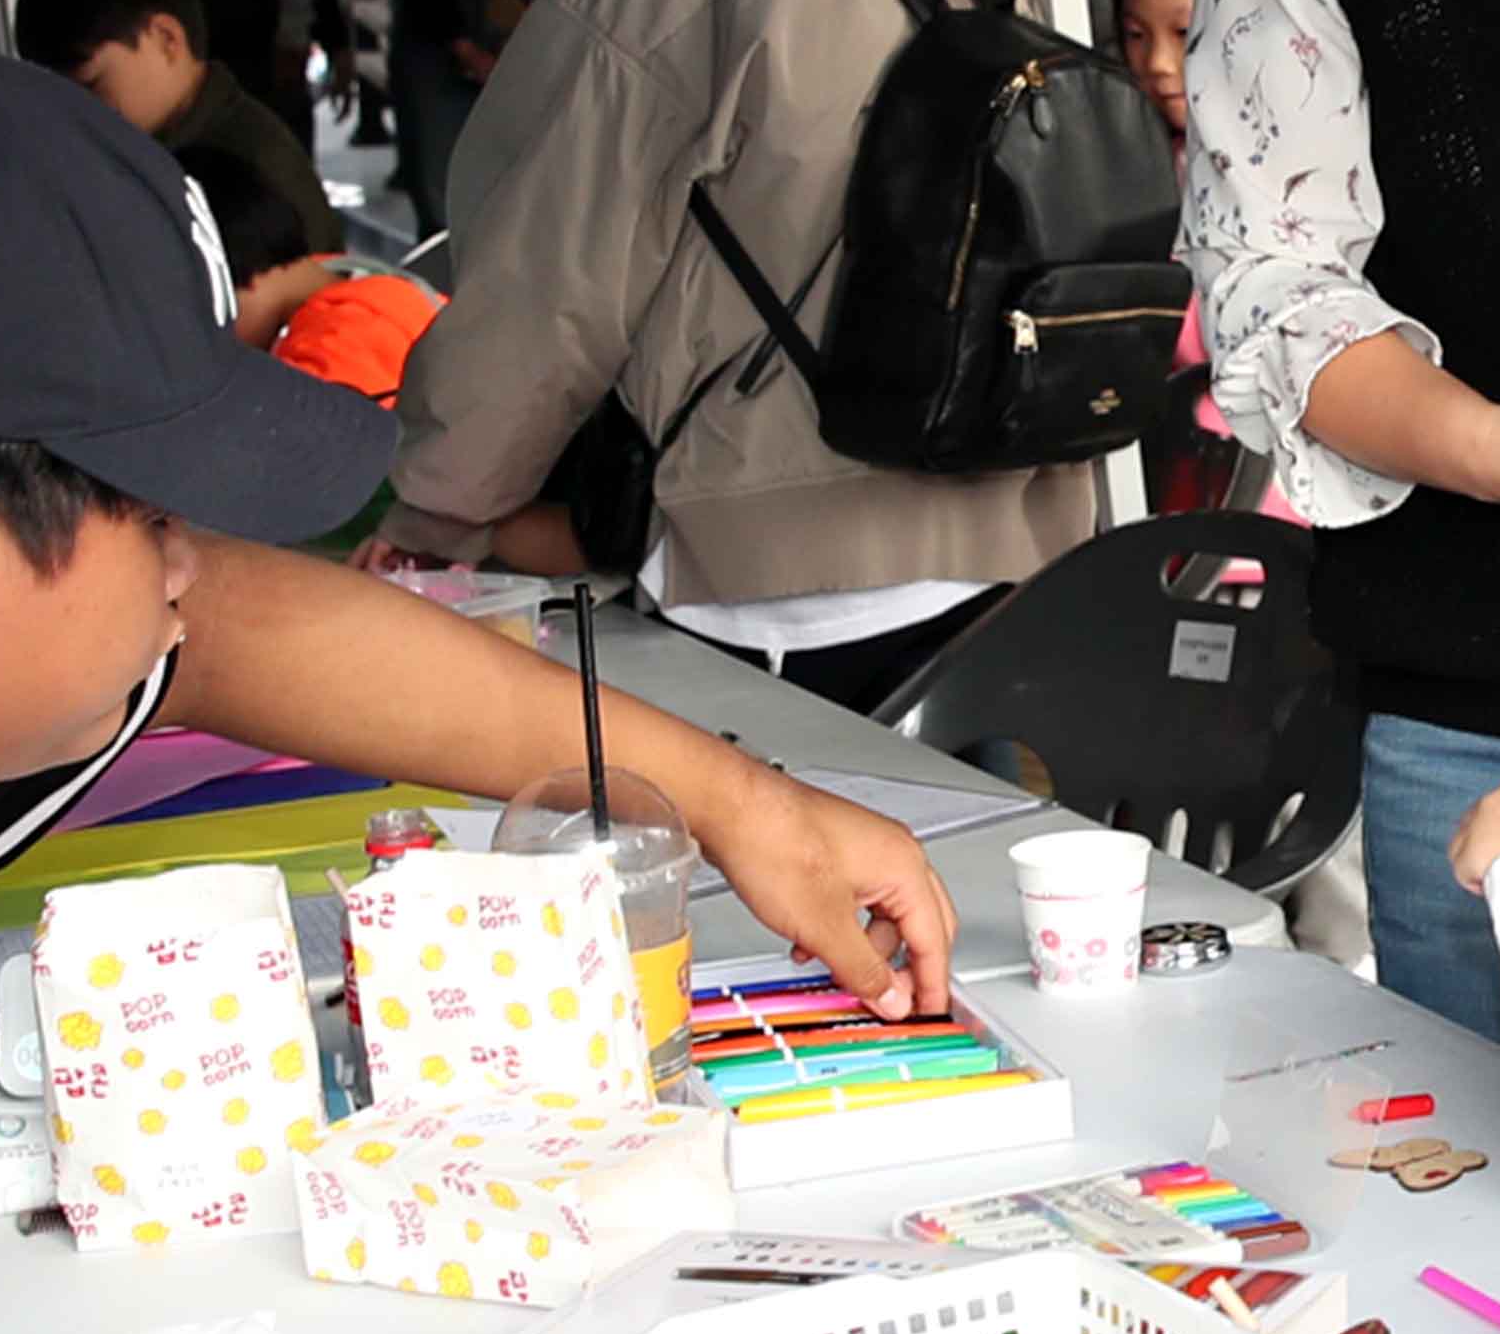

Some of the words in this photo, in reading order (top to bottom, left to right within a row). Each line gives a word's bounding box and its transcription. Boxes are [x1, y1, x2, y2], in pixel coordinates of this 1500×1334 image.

[478, 895, 517, 913] POP
[120, 992, 168, 1019] POP
[428, 988, 468, 1006] POP
[198, 1042, 245, 1069] POP
[52, 1063, 109, 1099] 팝콘
[191, 1192, 249, 1228] 팝콘
